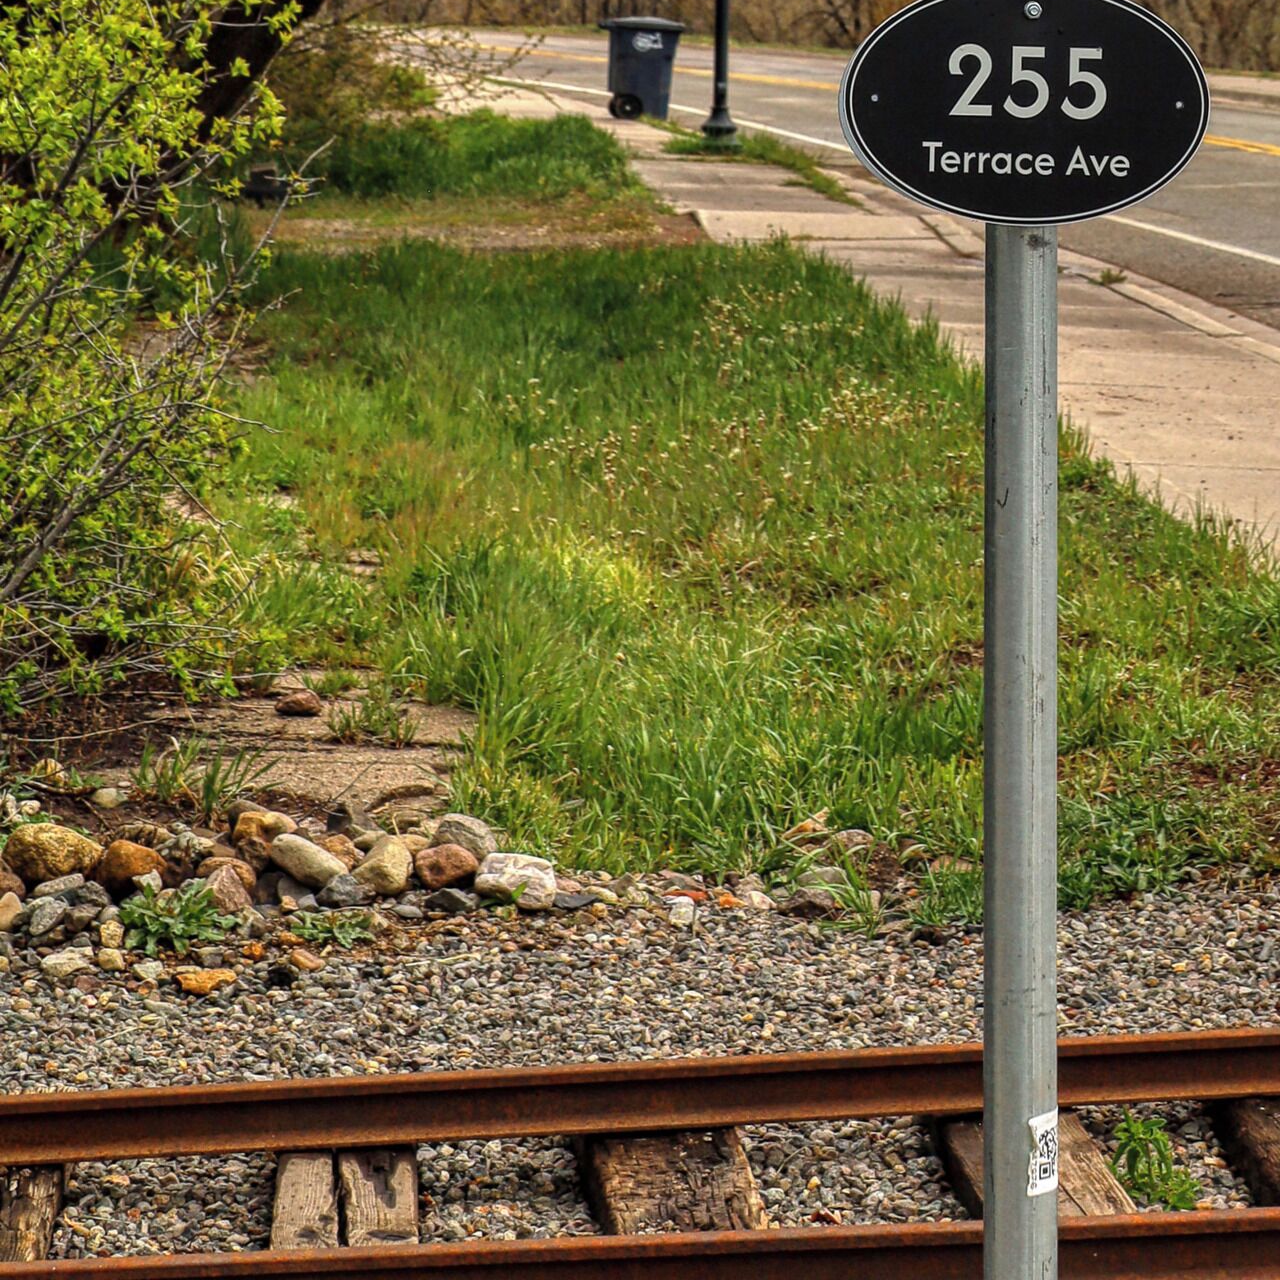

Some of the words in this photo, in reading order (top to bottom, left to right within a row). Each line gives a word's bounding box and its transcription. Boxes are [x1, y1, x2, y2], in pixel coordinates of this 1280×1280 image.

[948, 43, 1107, 120] 255
[922, 141, 1056, 176] Terrace
[1065, 145, 1131, 177] Ave
